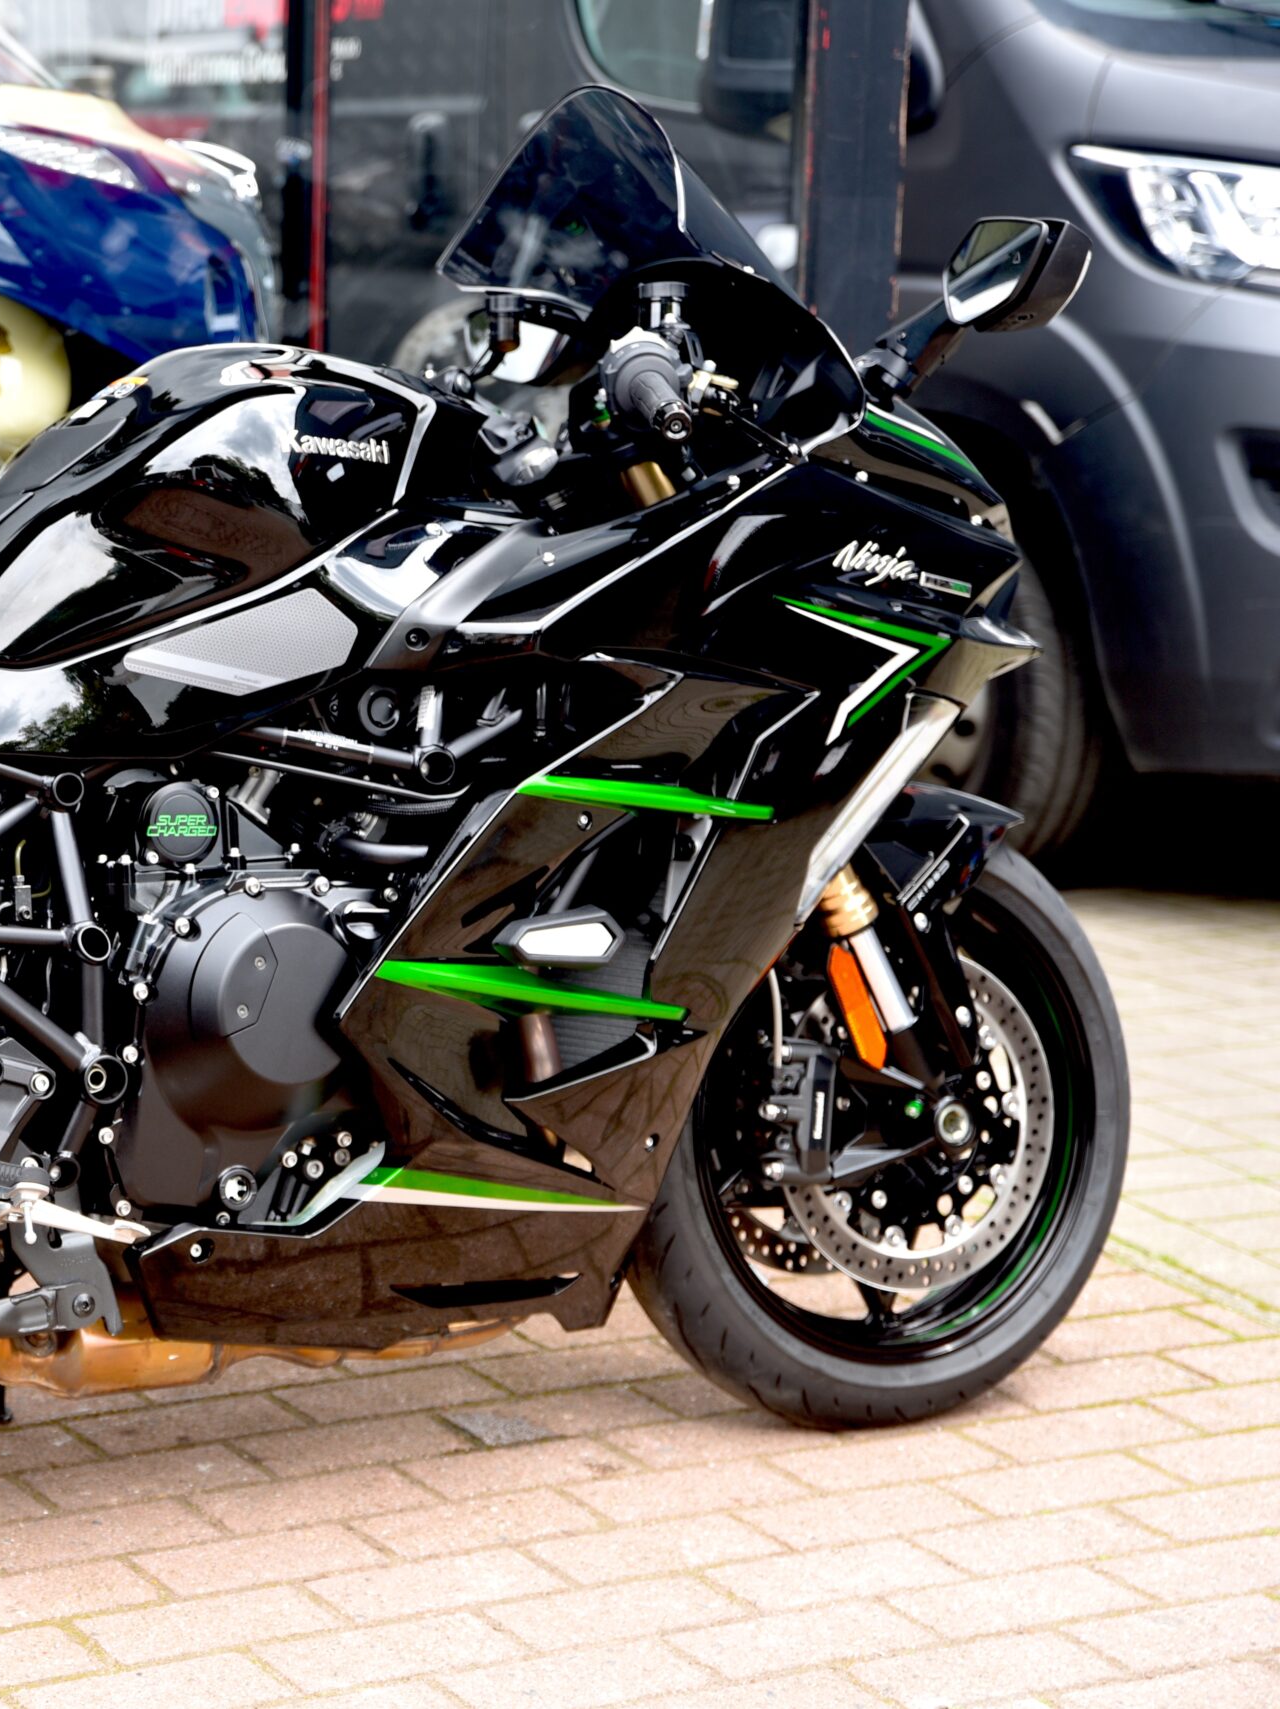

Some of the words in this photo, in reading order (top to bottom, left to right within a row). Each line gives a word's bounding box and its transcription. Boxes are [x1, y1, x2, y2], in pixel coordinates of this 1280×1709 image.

[280, 429, 390, 464] Kawasaki
[832, 540, 919, 586] Ninja
[146, 825, 217, 837] CHARGED
[156, 814, 207, 826] SUPER
